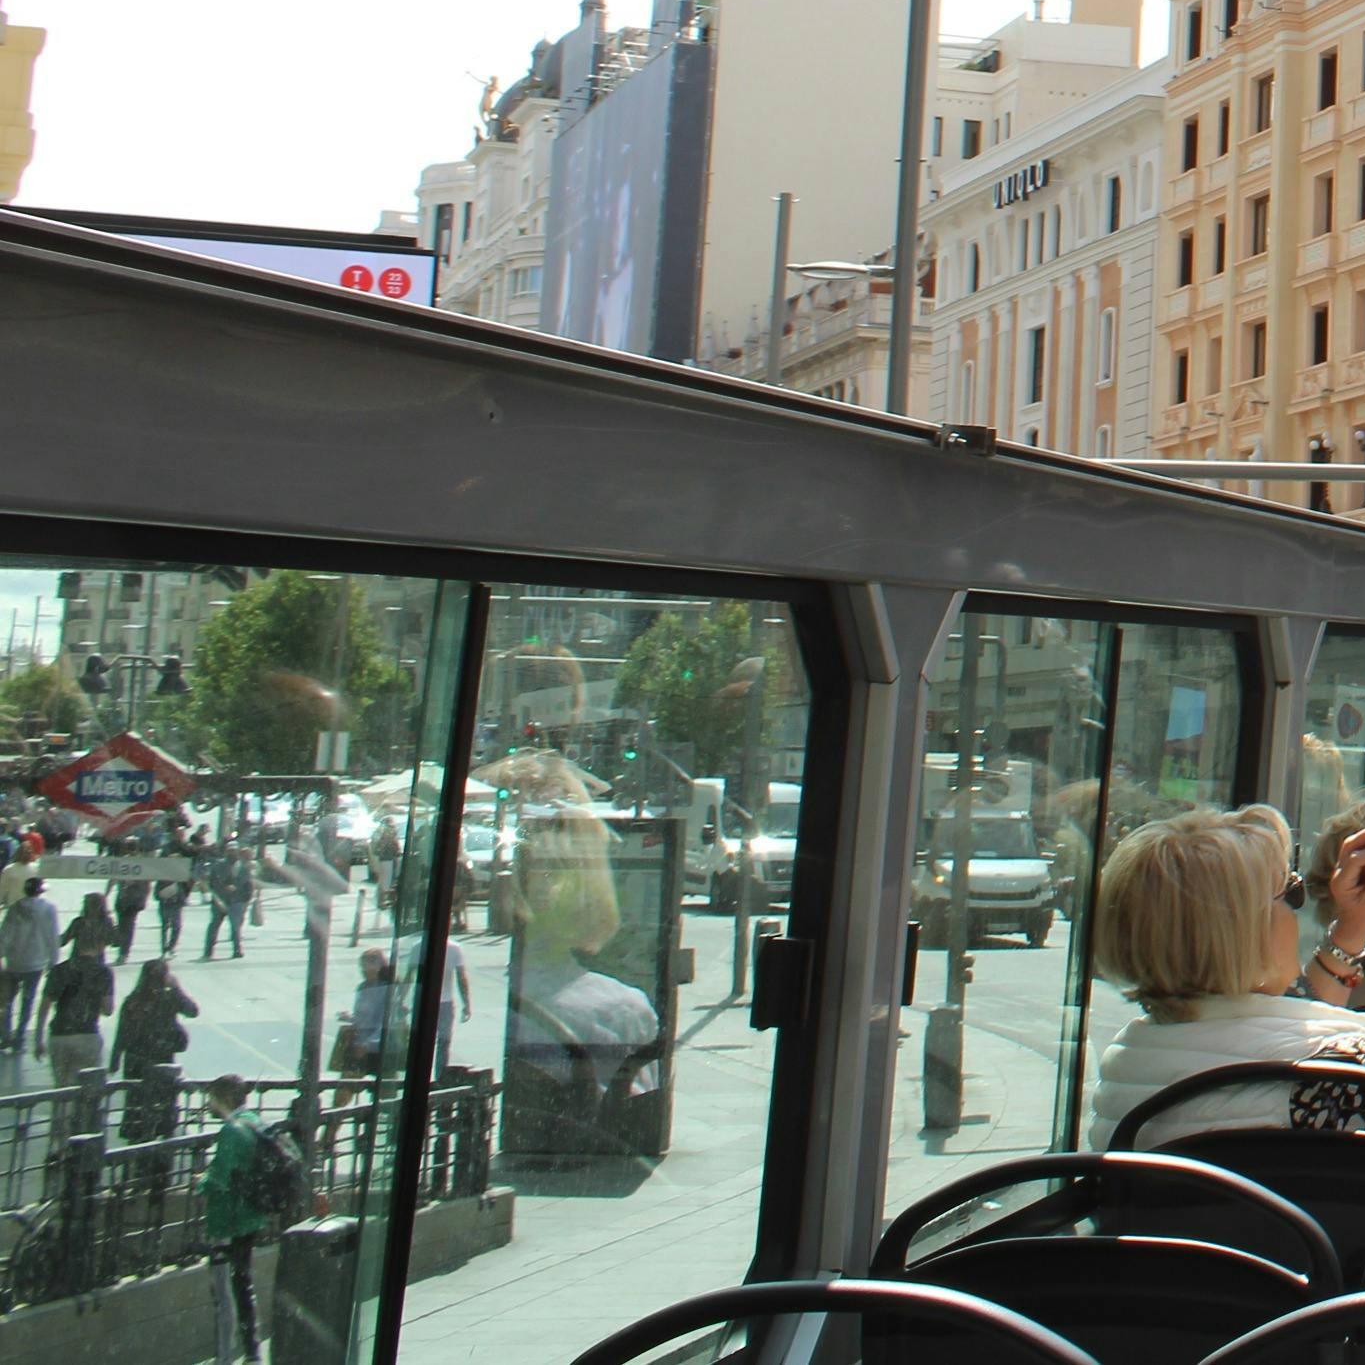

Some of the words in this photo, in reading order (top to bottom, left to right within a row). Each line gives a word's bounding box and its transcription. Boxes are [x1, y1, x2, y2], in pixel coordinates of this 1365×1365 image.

[993, 159, 1049, 209] UNIQLO
[81, 775, 150, 797] Metro
[85, 860, 143, 876] Callao
